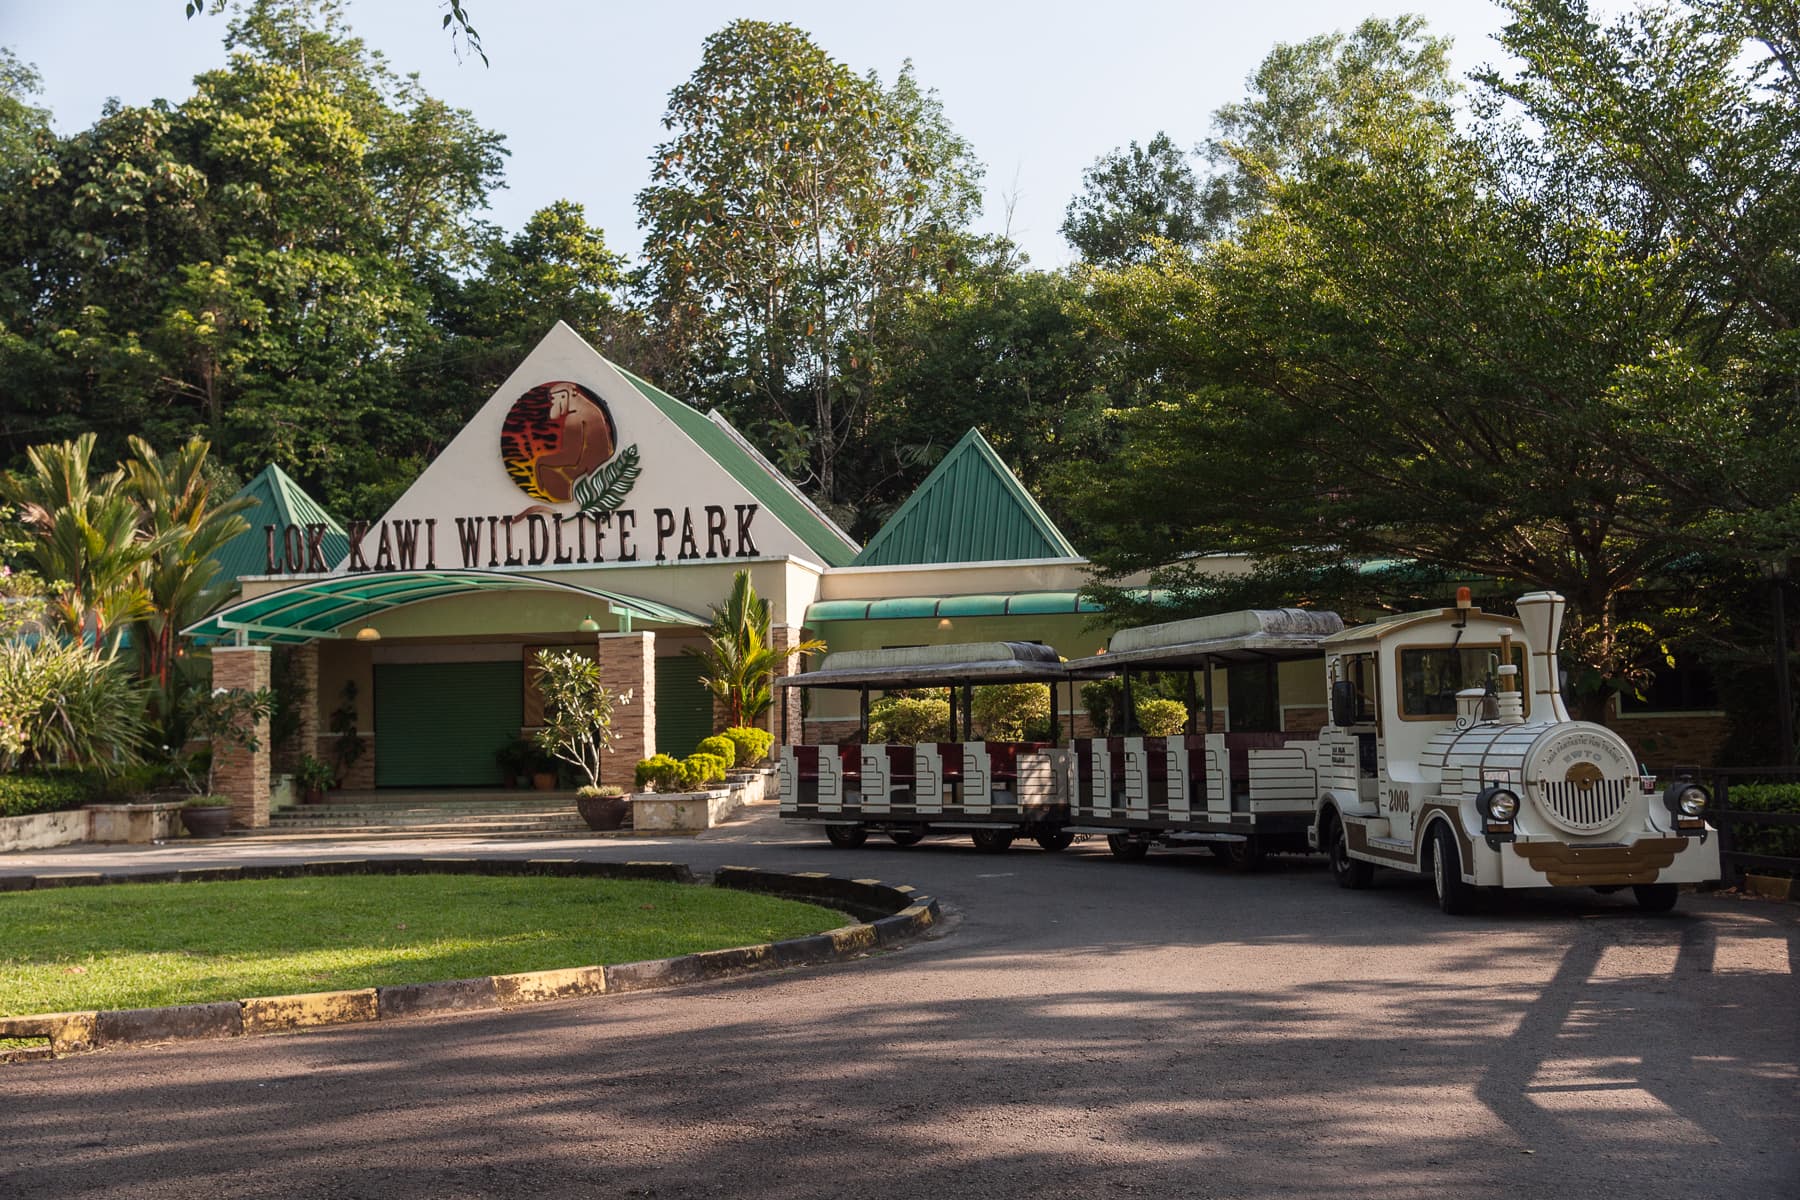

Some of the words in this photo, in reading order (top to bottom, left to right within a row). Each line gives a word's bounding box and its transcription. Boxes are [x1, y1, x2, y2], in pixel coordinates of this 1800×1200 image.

[264, 523, 330, 575] LOK
[347, 519, 437, 571] KAWI
[455, 509, 637, 568] WILDLIFE
[654, 504, 760, 561] PARK
[1388, 789, 1410, 813] 2008
